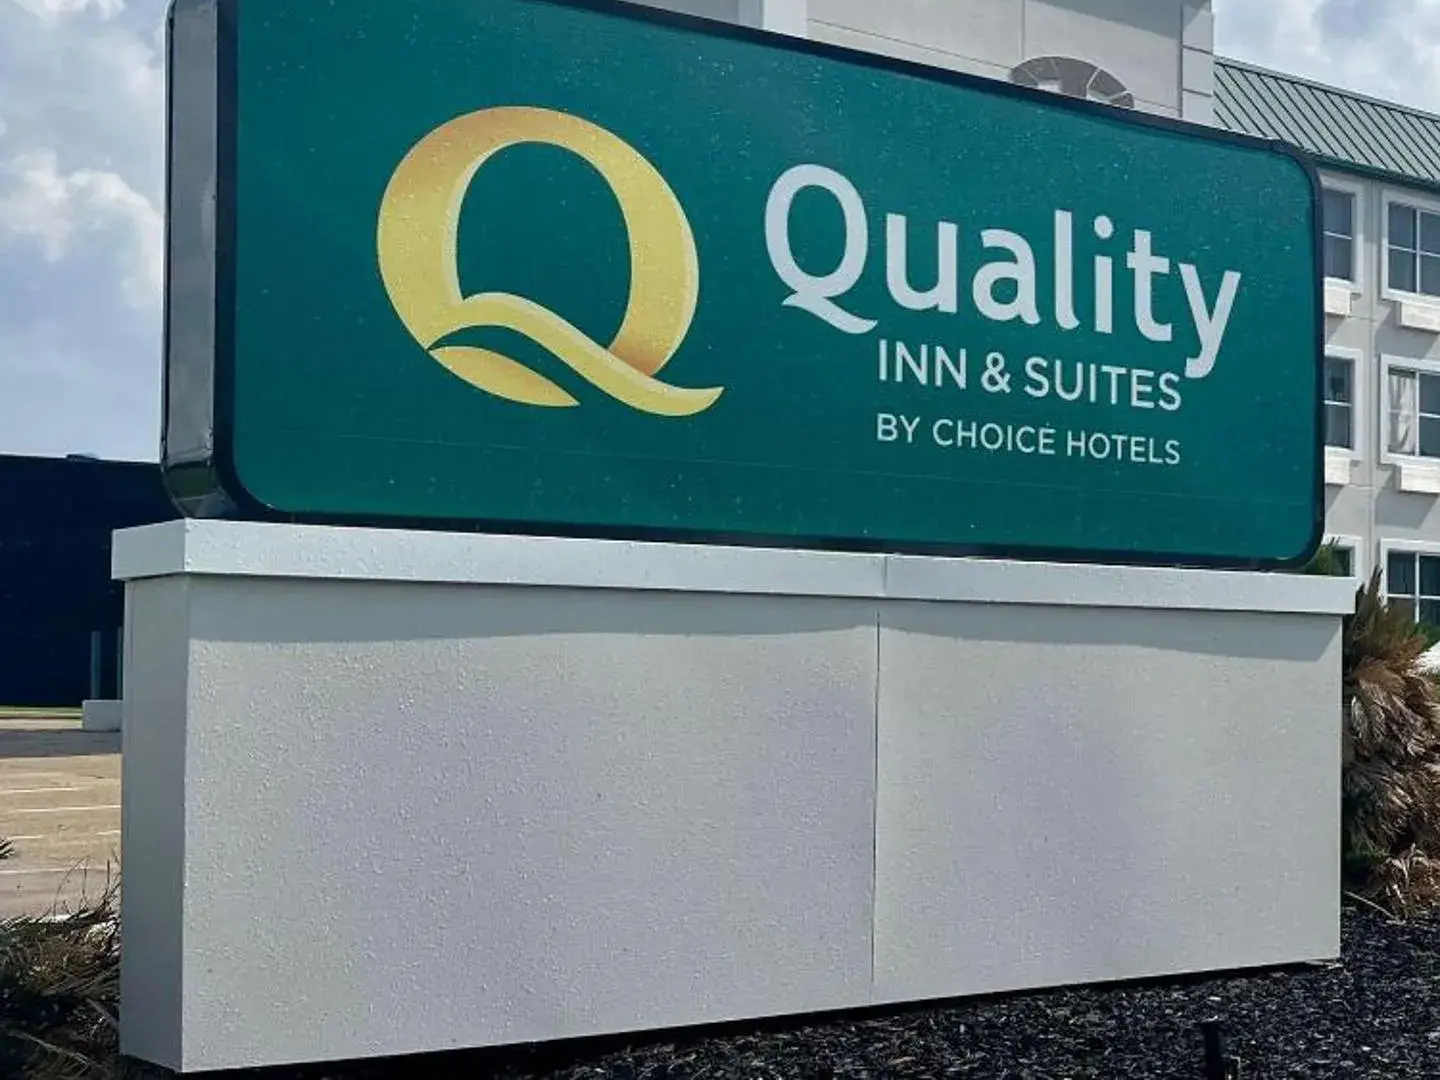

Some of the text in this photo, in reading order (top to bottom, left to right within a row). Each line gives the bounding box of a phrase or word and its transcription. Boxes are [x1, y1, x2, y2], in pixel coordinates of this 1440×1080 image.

[376, 106, 724, 417] Q
[764, 163, 1242, 378] Quality
[876, 413, 1181, 465] BY CHOICE HOTELS
[878, 338, 1182, 411] INN & SUITES
